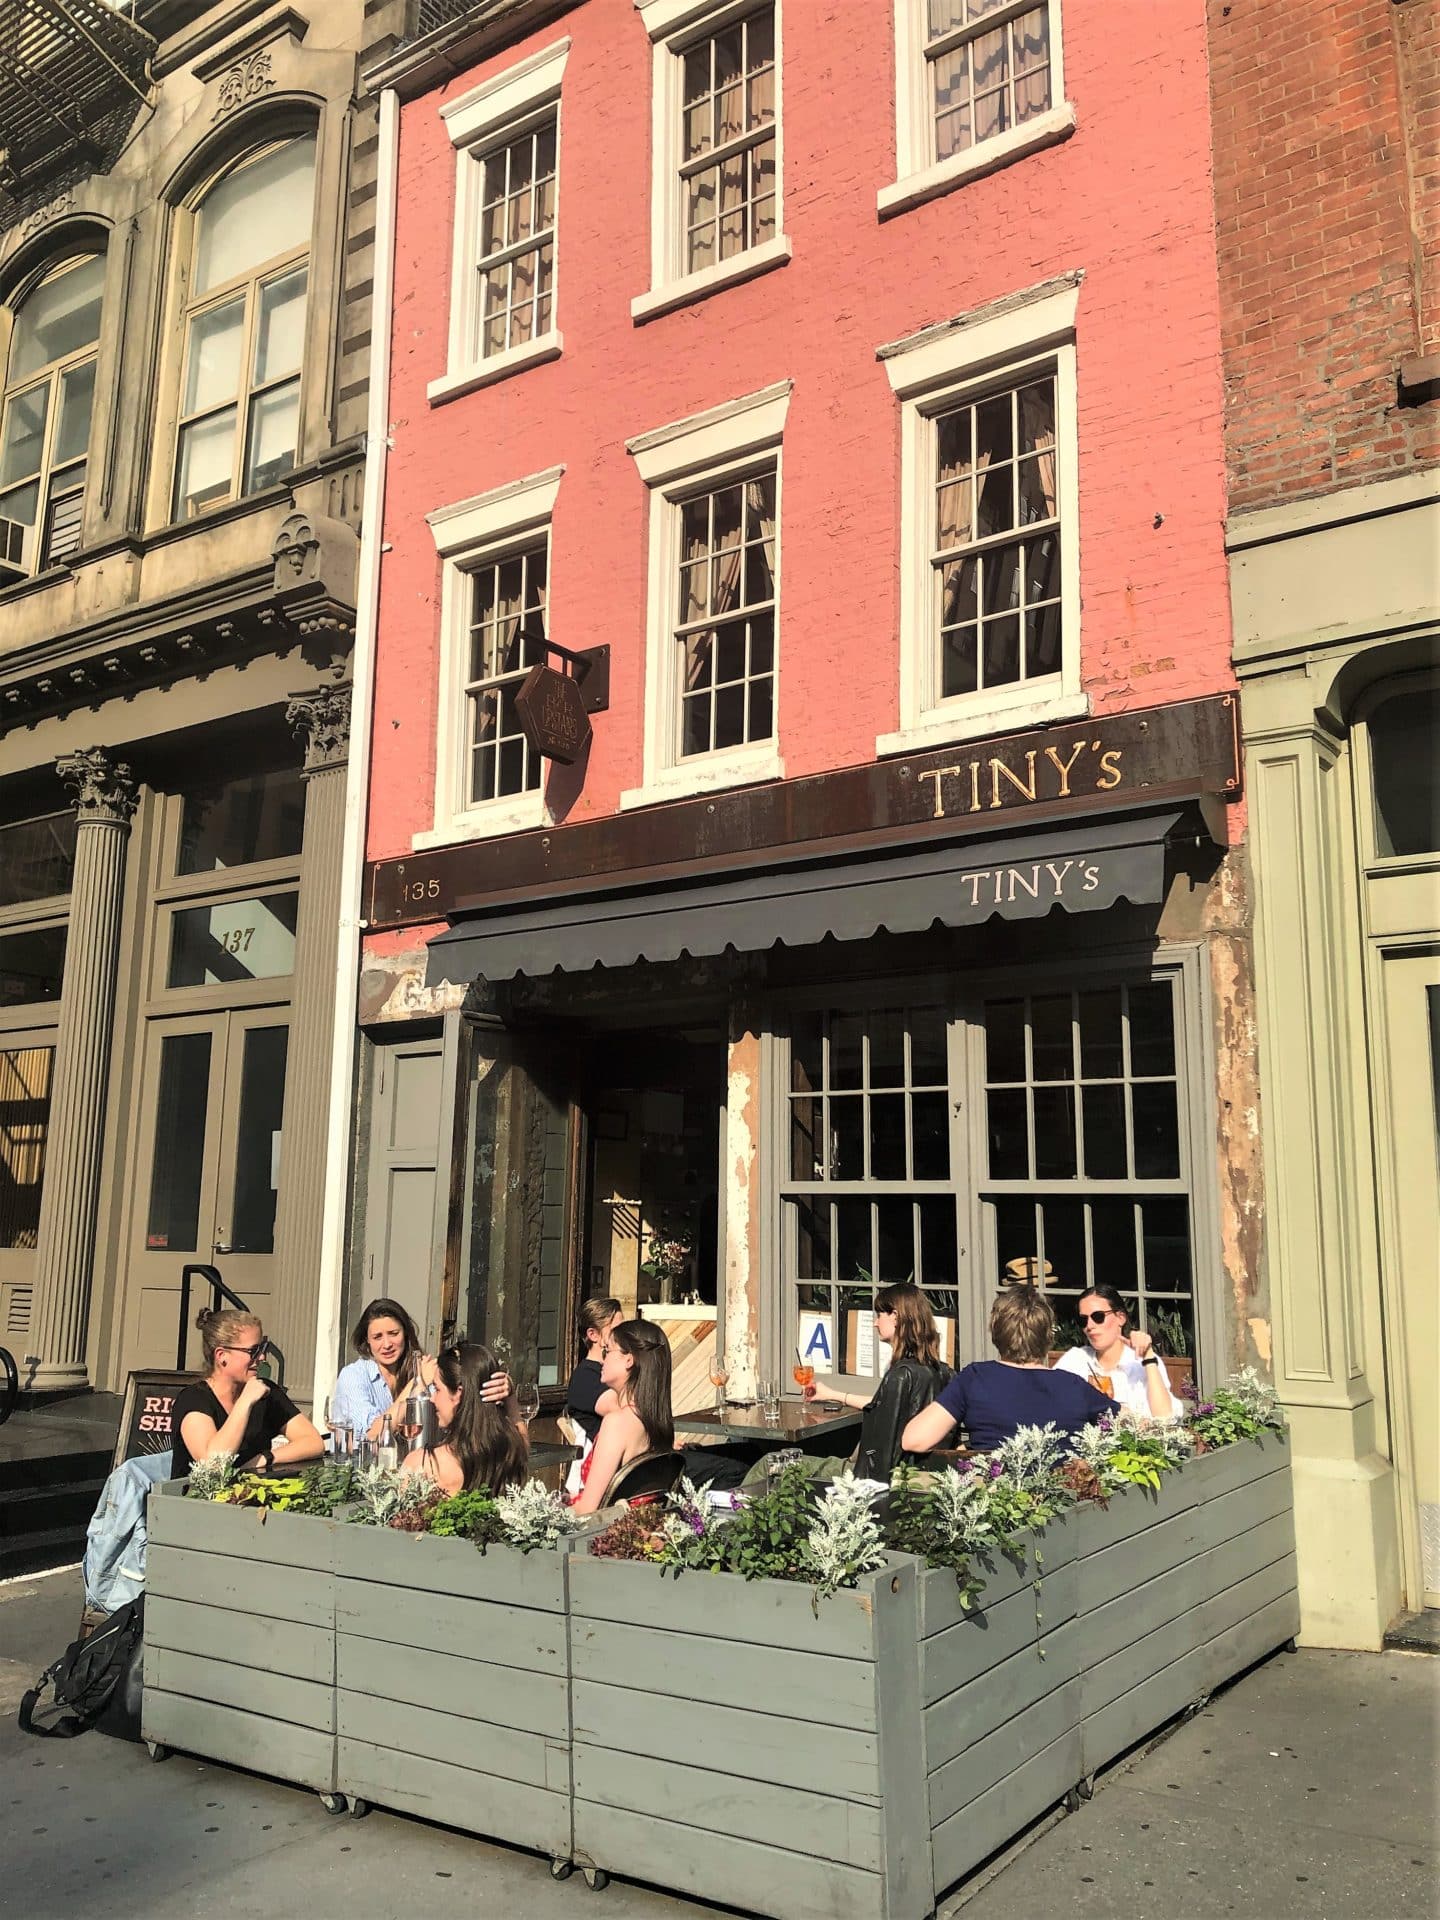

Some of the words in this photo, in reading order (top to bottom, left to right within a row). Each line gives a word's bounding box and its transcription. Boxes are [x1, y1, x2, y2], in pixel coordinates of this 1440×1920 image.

[918, 740, 1123, 818] TINY's
[402, 879, 441, 902] 135
[960, 860, 1100, 906] TINY's
[219, 927, 256, 955] 137
[804, 1323, 831, 1359] A
[143, 1397, 176, 1414] RI
